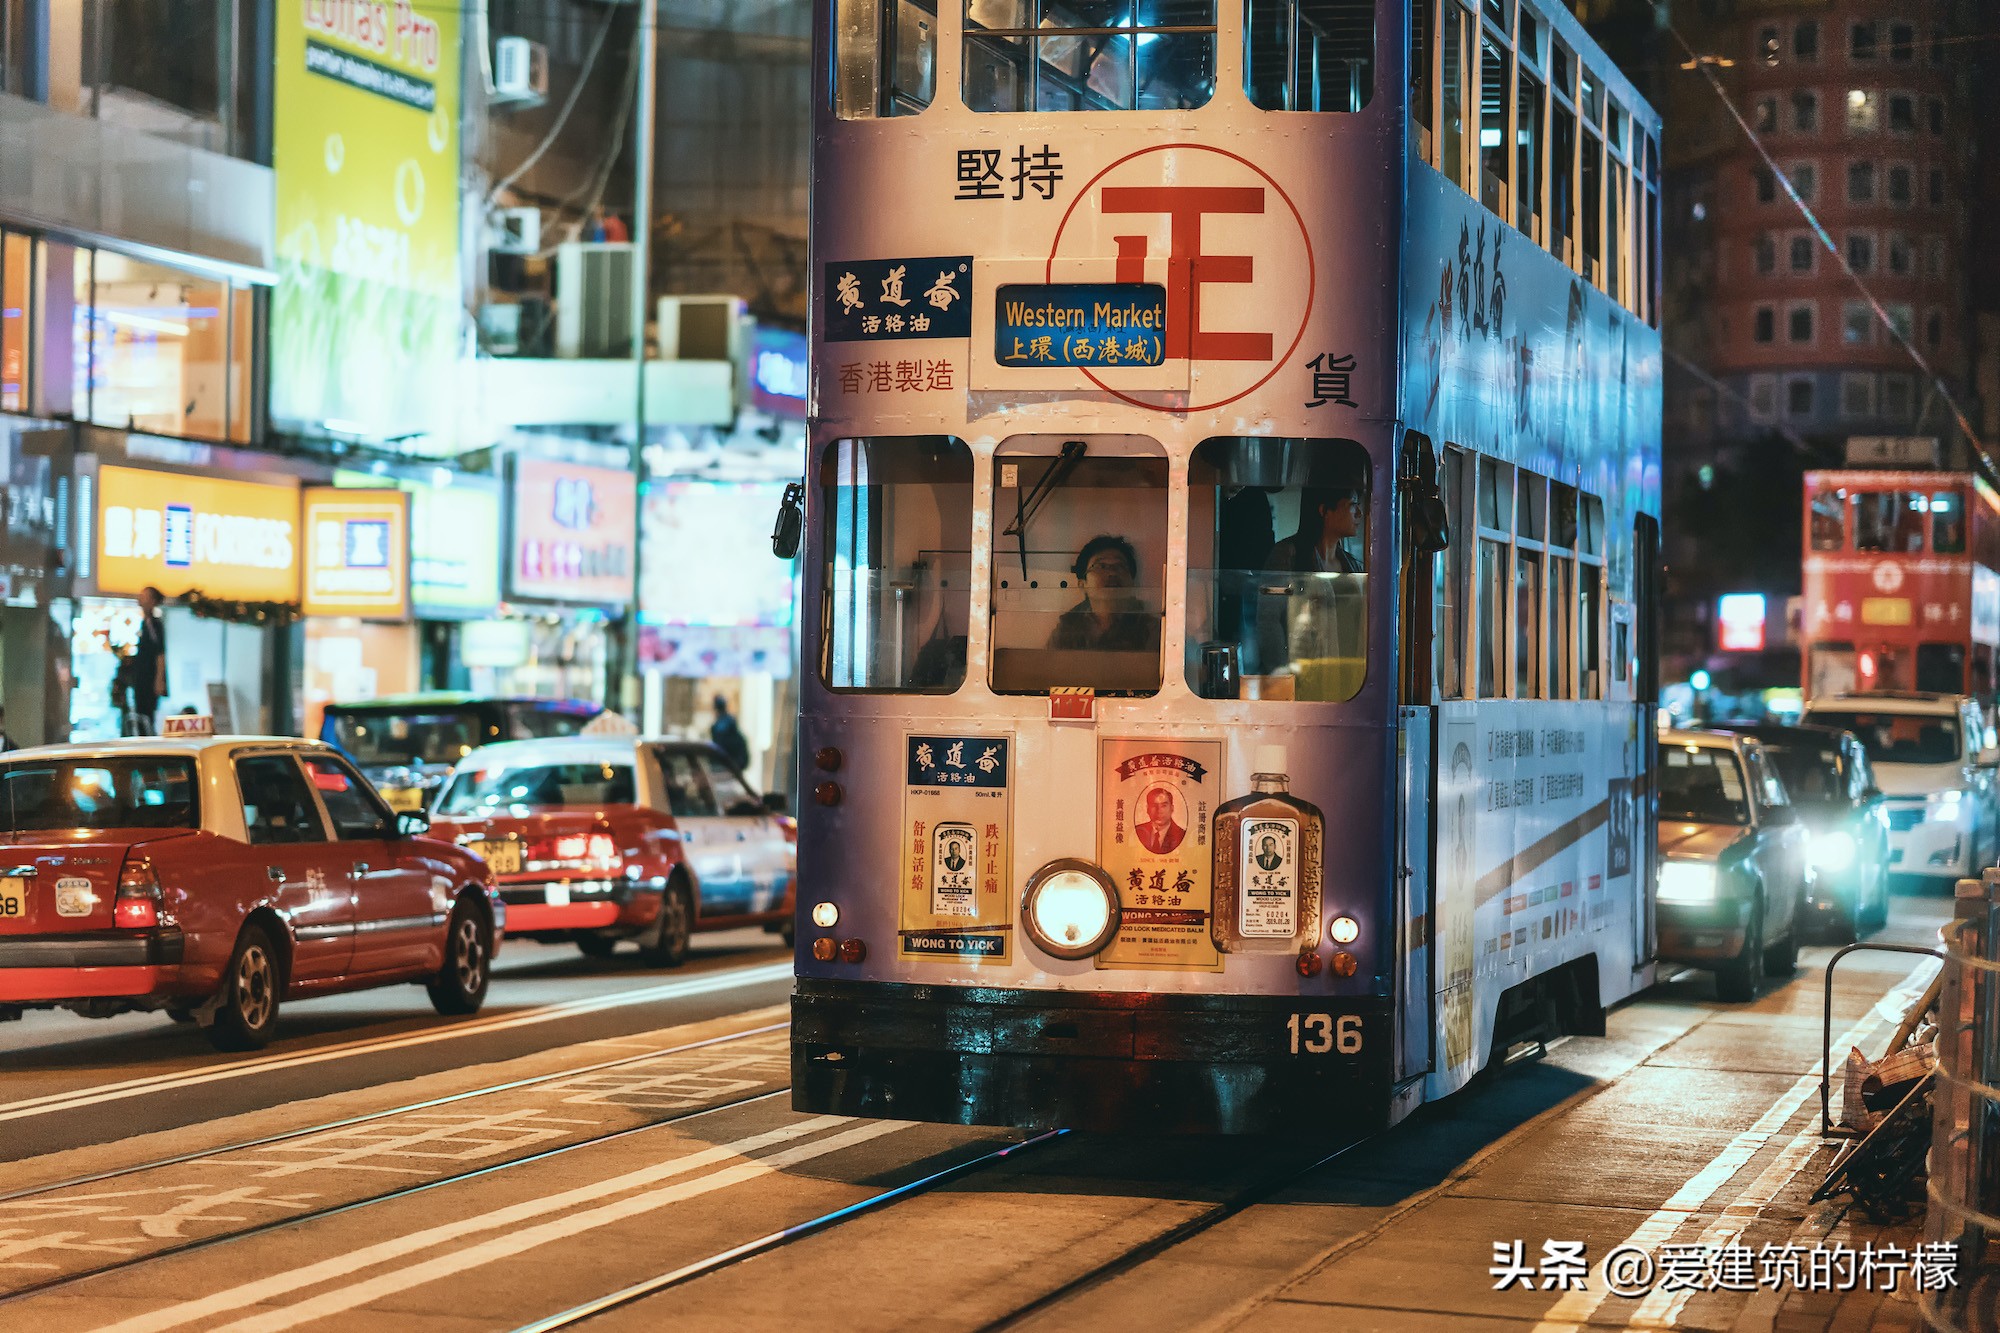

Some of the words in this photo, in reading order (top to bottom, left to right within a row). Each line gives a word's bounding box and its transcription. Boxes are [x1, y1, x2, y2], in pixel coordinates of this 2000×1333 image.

[954, 144, 1064, 201] 堅持
[1101, 186, 1273, 361] 正
[862, 313, 931, 334] 活絡油
[1005, 301, 1085, 328] Western
[1093, 302, 1162, 329] Market
[838, 360, 955, 396] 香港製造
[1305, 352, 1359, 409] 貨
[166, 719, 207, 732] TAXI
[937, 771, 976, 784] 活絡油
[911, 820, 926, 891] 舒筋活絡
[984, 823, 999, 894] 跌打止痛
[1126, 869, 1195, 893] 黃道益
[1135, 894, 1182, 906] 活絡油
[912, 937, 945, 949] WONG
[949, 938, 964, 950] TO
[967, 940, 995, 951] YICK
[1287, 1013, 1363, 1055] 136
